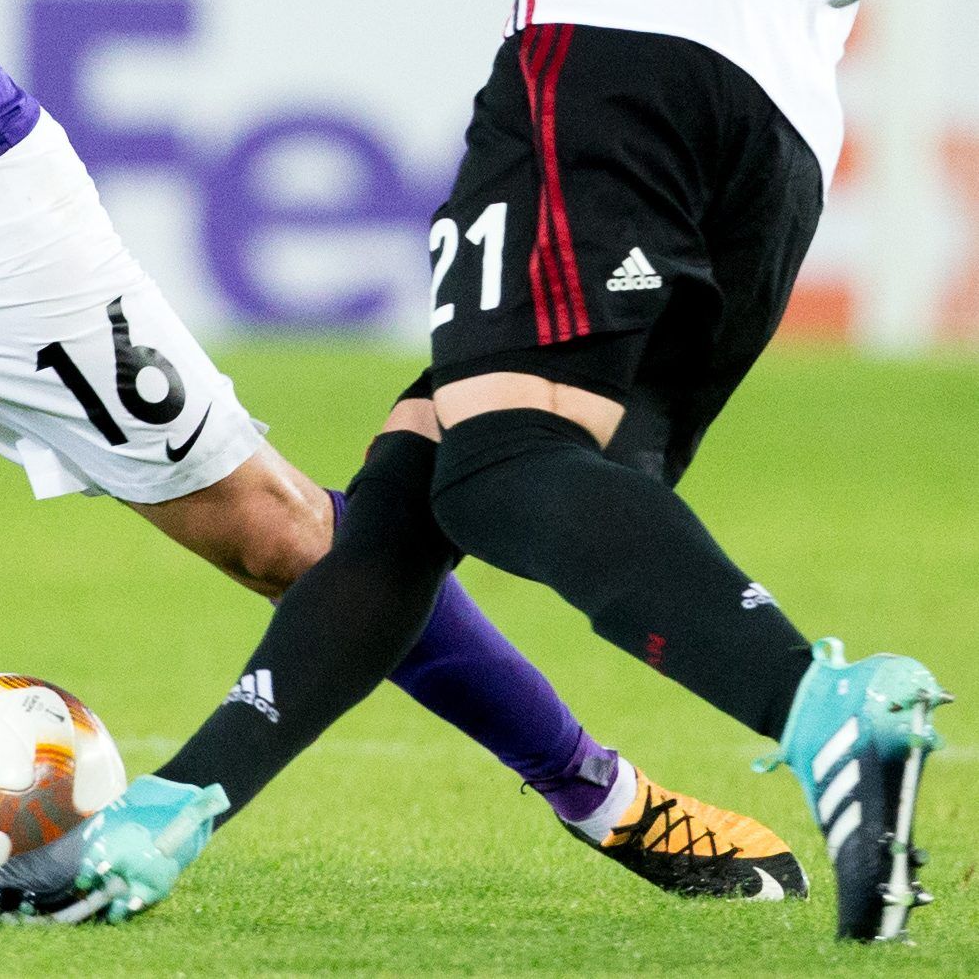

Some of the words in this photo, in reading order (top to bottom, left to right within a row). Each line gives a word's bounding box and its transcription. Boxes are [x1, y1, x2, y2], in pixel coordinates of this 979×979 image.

[428, 202, 508, 335] 21
[606, 276, 662, 292] adidas
[35, 295, 186, 447] 16
